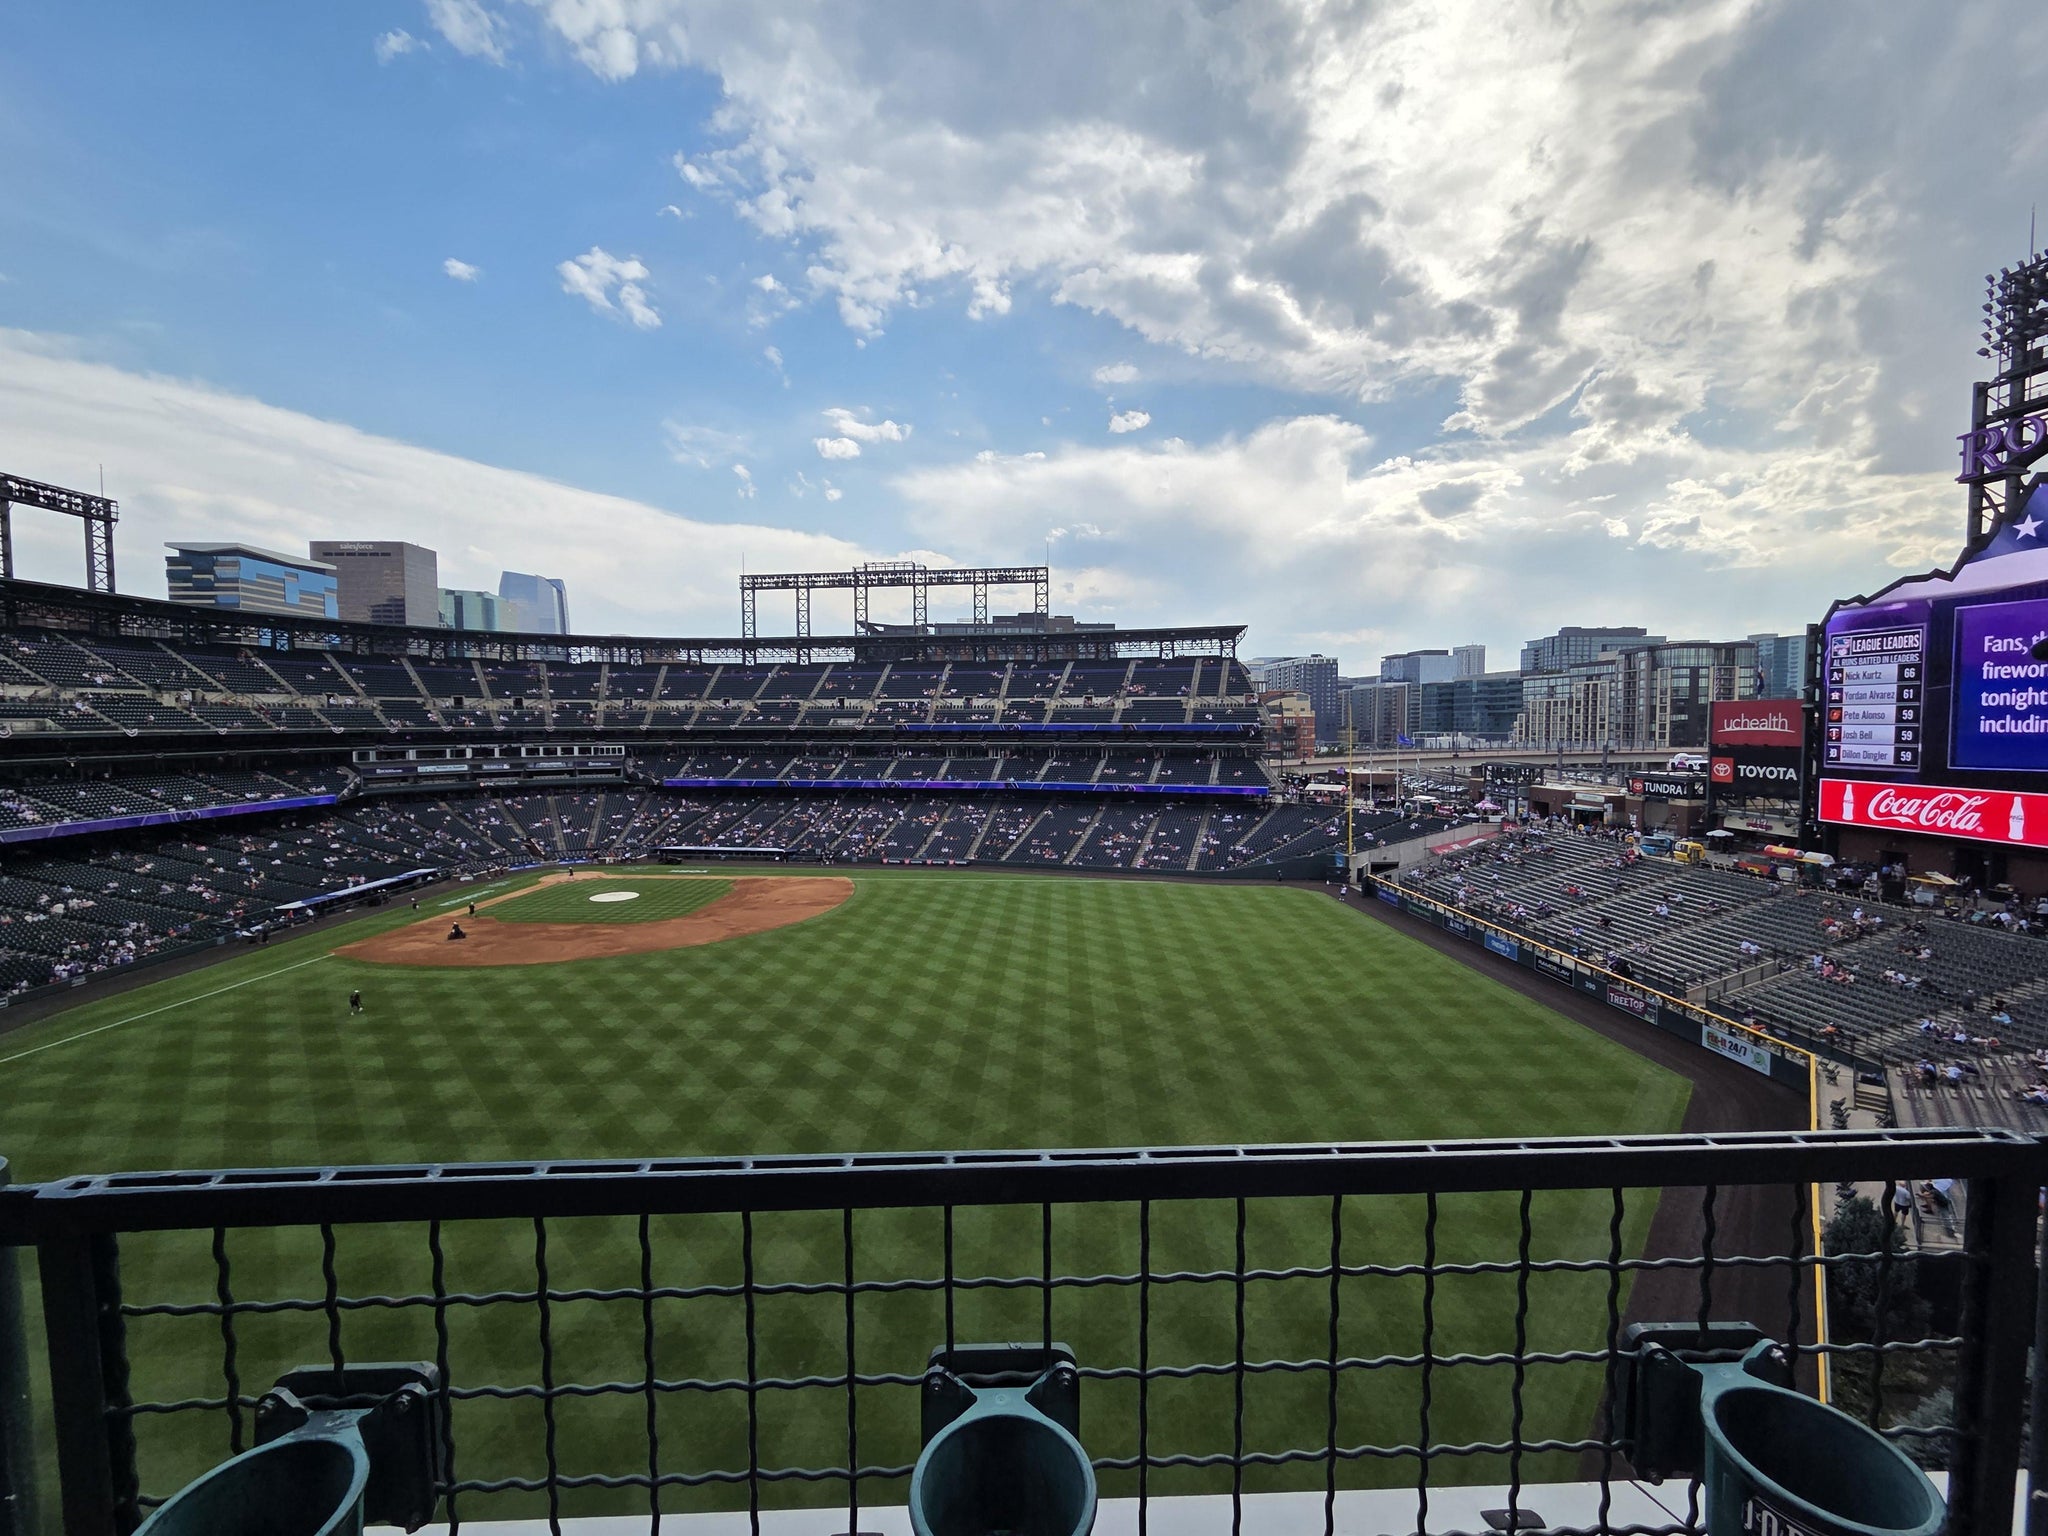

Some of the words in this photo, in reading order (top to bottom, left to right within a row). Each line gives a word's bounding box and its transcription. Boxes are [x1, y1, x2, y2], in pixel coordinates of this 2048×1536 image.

[340, 543, 374, 551] salesforce
[1852, 638, 1882, 653] LEAGUE
[1883, 634, 1920, 650] LEADERS
[1984, 635, 2029, 655] Fans,
[1841, 657, 1857, 666] RUNS
[1858, 655, 1880, 665] BATTED
[1882, 655, 1889, 663] IN
[1890, 653, 1920, 663] LEADERS
[1845, 671, 1860, 680] Nick
[1862, 670, 1882, 680] Kurtz
[1904, 668, 1916, 678] 66
[1844, 691, 1867, 701] Yordan
[1869, 690, 1895, 700] Alvarez
[1903, 688, 1914, 699] 61
[1844, 710, 1860, 720] Pete
[1861, 710, 1885, 720] Alonso
[1902, 709, 1914, 720] 59
[1724, 713, 1788, 731] uchealth
[1843, 730, 1857, 740] Josh
[1860, 730, 1873, 740] Bell
[1901, 730, 1913, 741] 59
[1842, 749, 1861, 759] Dillon
[1862, 750, 1888, 761] Dingler
[1900, 751, 1912, 761] 59
[1737, 765, 1798, 781] TOYOTA
[1644, 782, 1683, 795] TUNDRA
[1868, 788, 1990, 831] Coca-Cola
[1609, 992, 1645, 1009] TREETOP
[1728, 1040, 1747, 1056] 24/7
